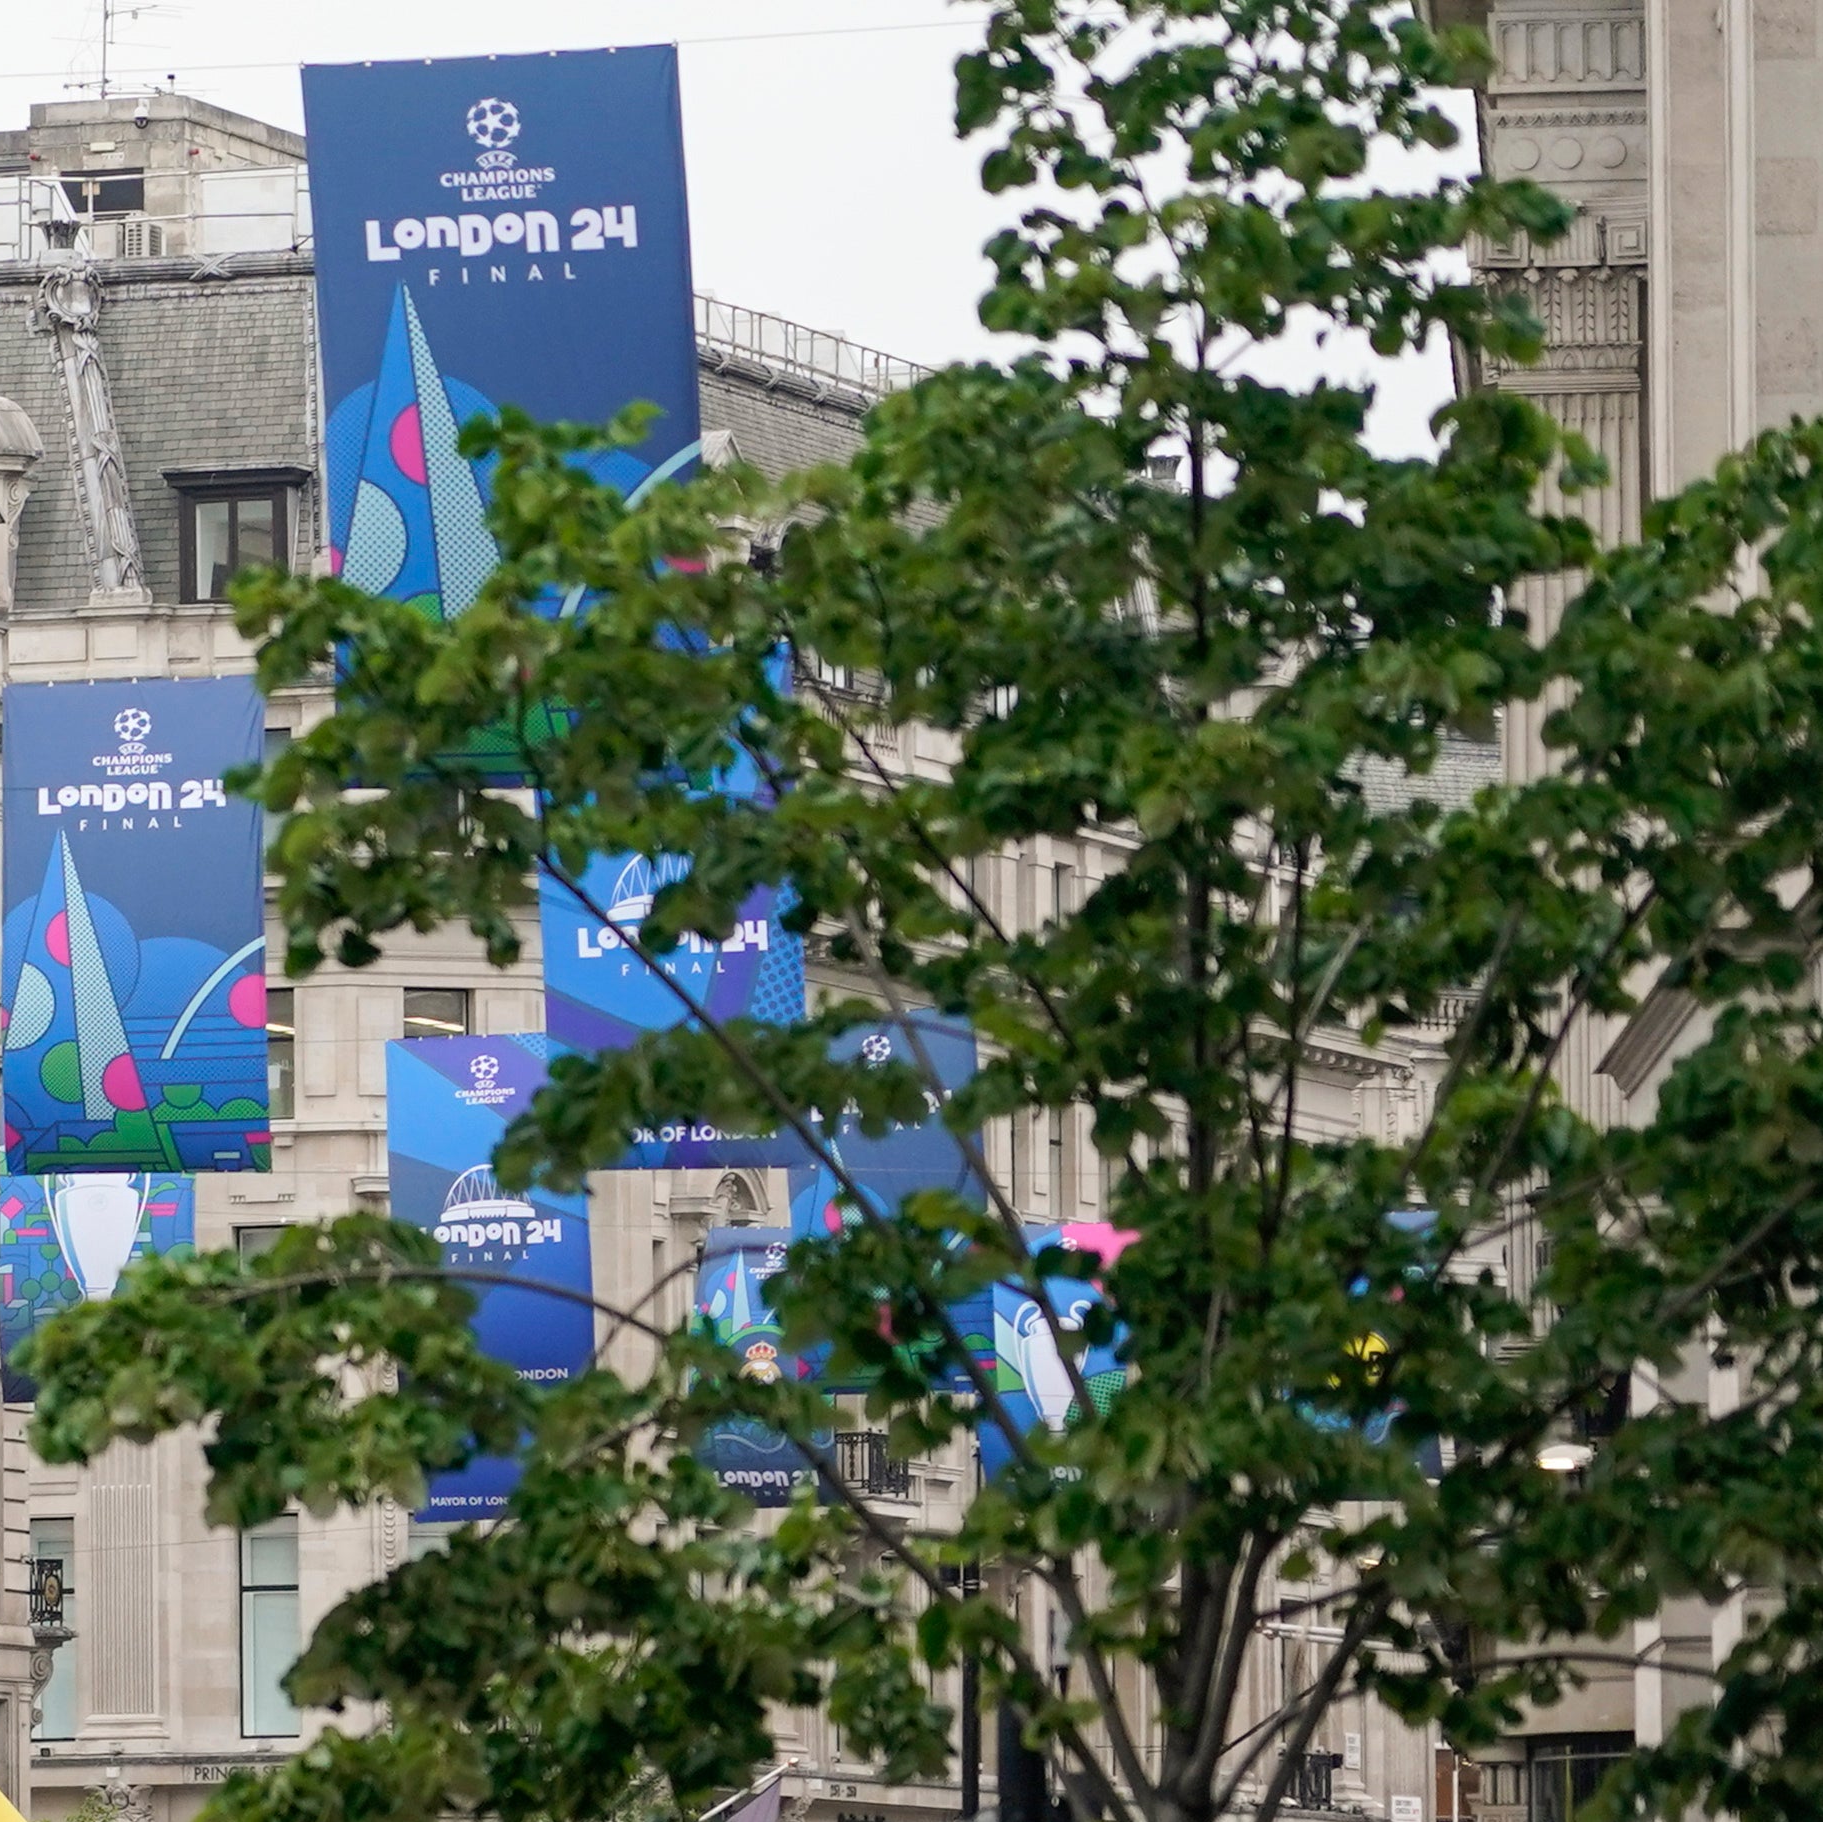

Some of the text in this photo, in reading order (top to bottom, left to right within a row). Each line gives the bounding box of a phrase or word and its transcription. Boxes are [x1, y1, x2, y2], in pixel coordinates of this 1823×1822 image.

[440, 168, 555, 188] CHAMPIONS
[462, 185, 537, 201] LEAGUE
[570, 205, 638, 250] 24
[428, 262, 576, 287] FINAL
[92, 753, 172, 767] CHAMPIONS
[106, 765, 159, 776] LEAGUE
[182, 779, 227, 808] 24
[79, 816, 182, 831] FINAL
[621, 960, 725, 977] FINAL
[455, 1087, 516, 1099] CHAMPIONS
[465, 1096, 506, 1105] LEAGUE
[659, 1126, 686, 1142] OF
[526, 1218, 562, 1244] 24
[451, 1250, 530, 1263] FINAL
[431, 1497, 467, 1507] MAYOR
[468, 1497, 482, 1506] OF
